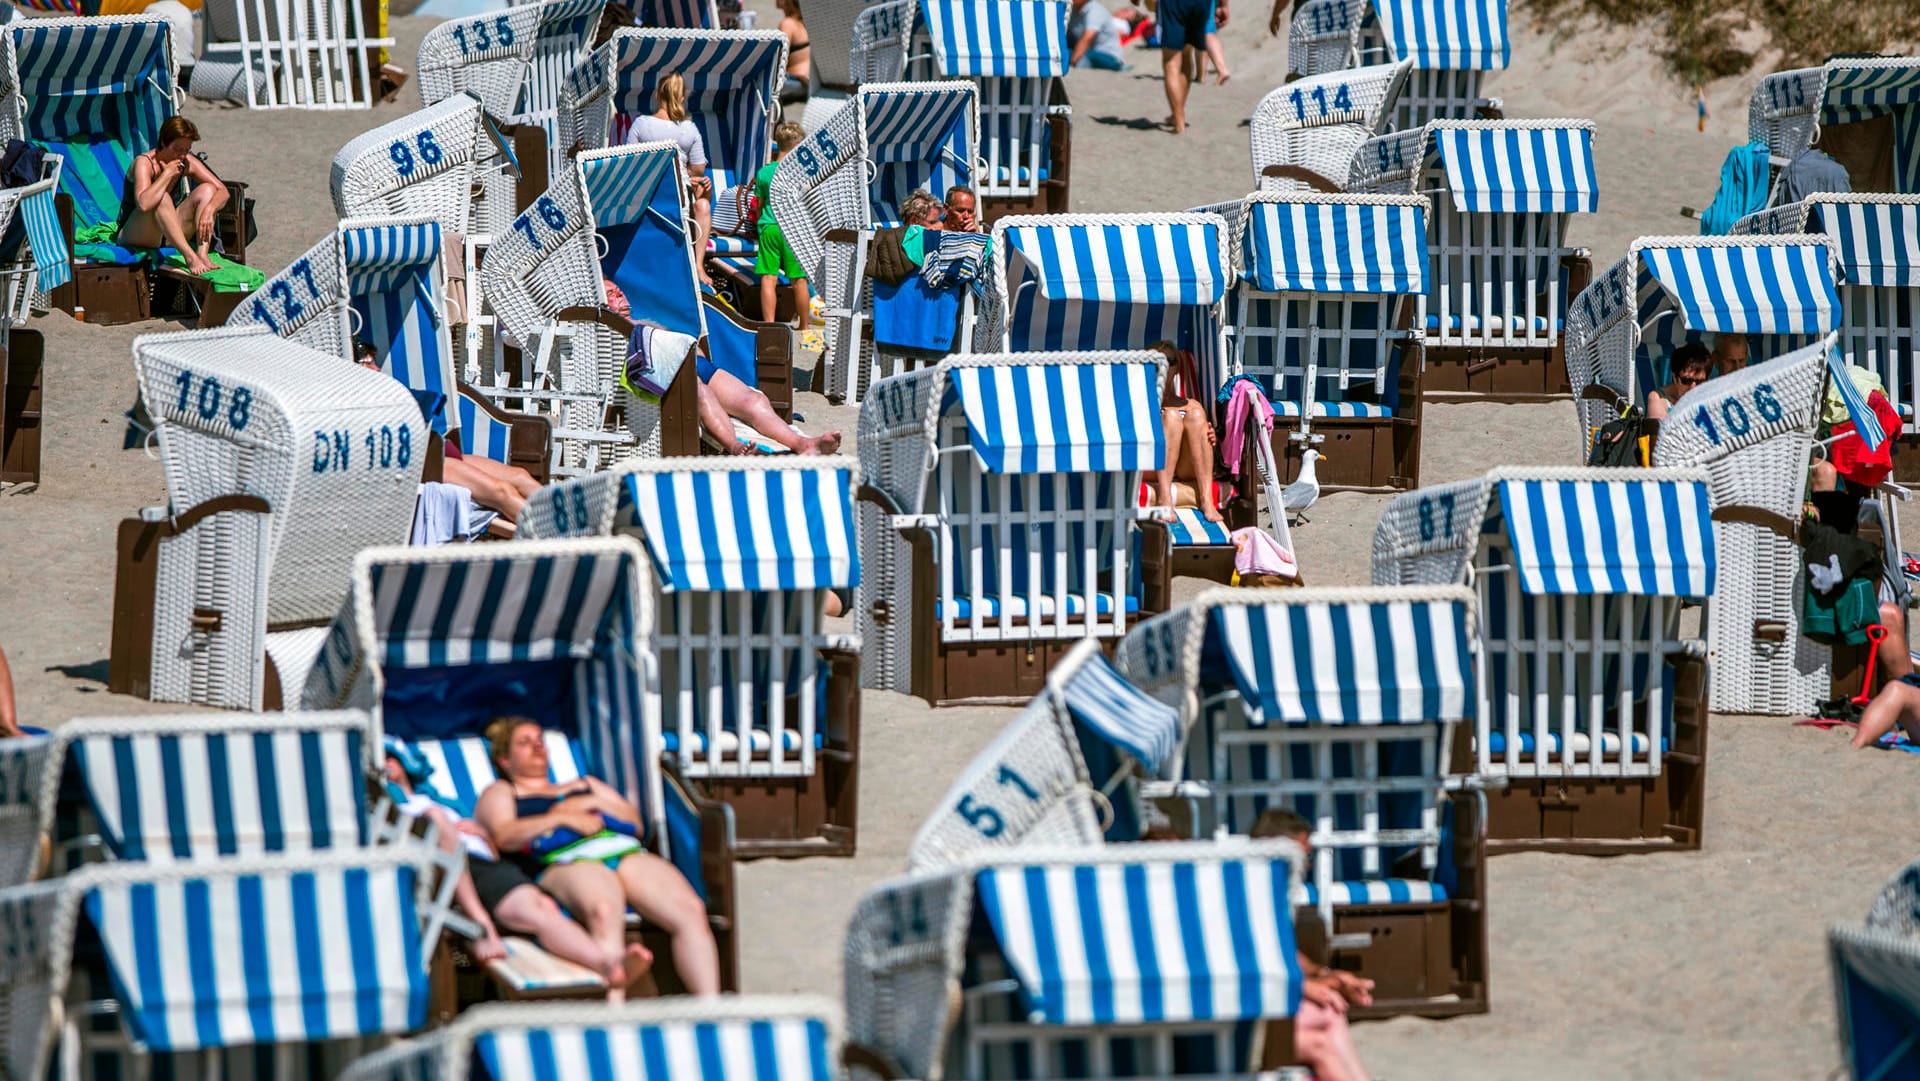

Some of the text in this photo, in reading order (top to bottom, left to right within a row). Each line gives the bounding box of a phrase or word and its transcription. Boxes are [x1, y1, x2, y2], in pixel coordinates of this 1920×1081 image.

[453, 15, 515, 55] 135
[870, 5, 900, 41] 134
[571, 53, 604, 99] 115
[1767, 75, 1806, 109] 113
[1288, 83, 1351, 121] 114
[389, 130, 443, 176] 96
[796, 129, 839, 176] 95
[1377, 137, 1404, 173] 94
[512, 196, 567, 251] 76
[251, 258, 320, 335] 127
[1582, 268, 1625, 330] 125
[176, 368, 252, 431] 108
[877, 376, 918, 426] 107
[1695, 382, 1783, 446] 106
[314, 423, 412, 473] DN 108
[553, 483, 587, 534] 88
[1418, 493, 1454, 542] 87
[955, 764, 1038, 838] 51
